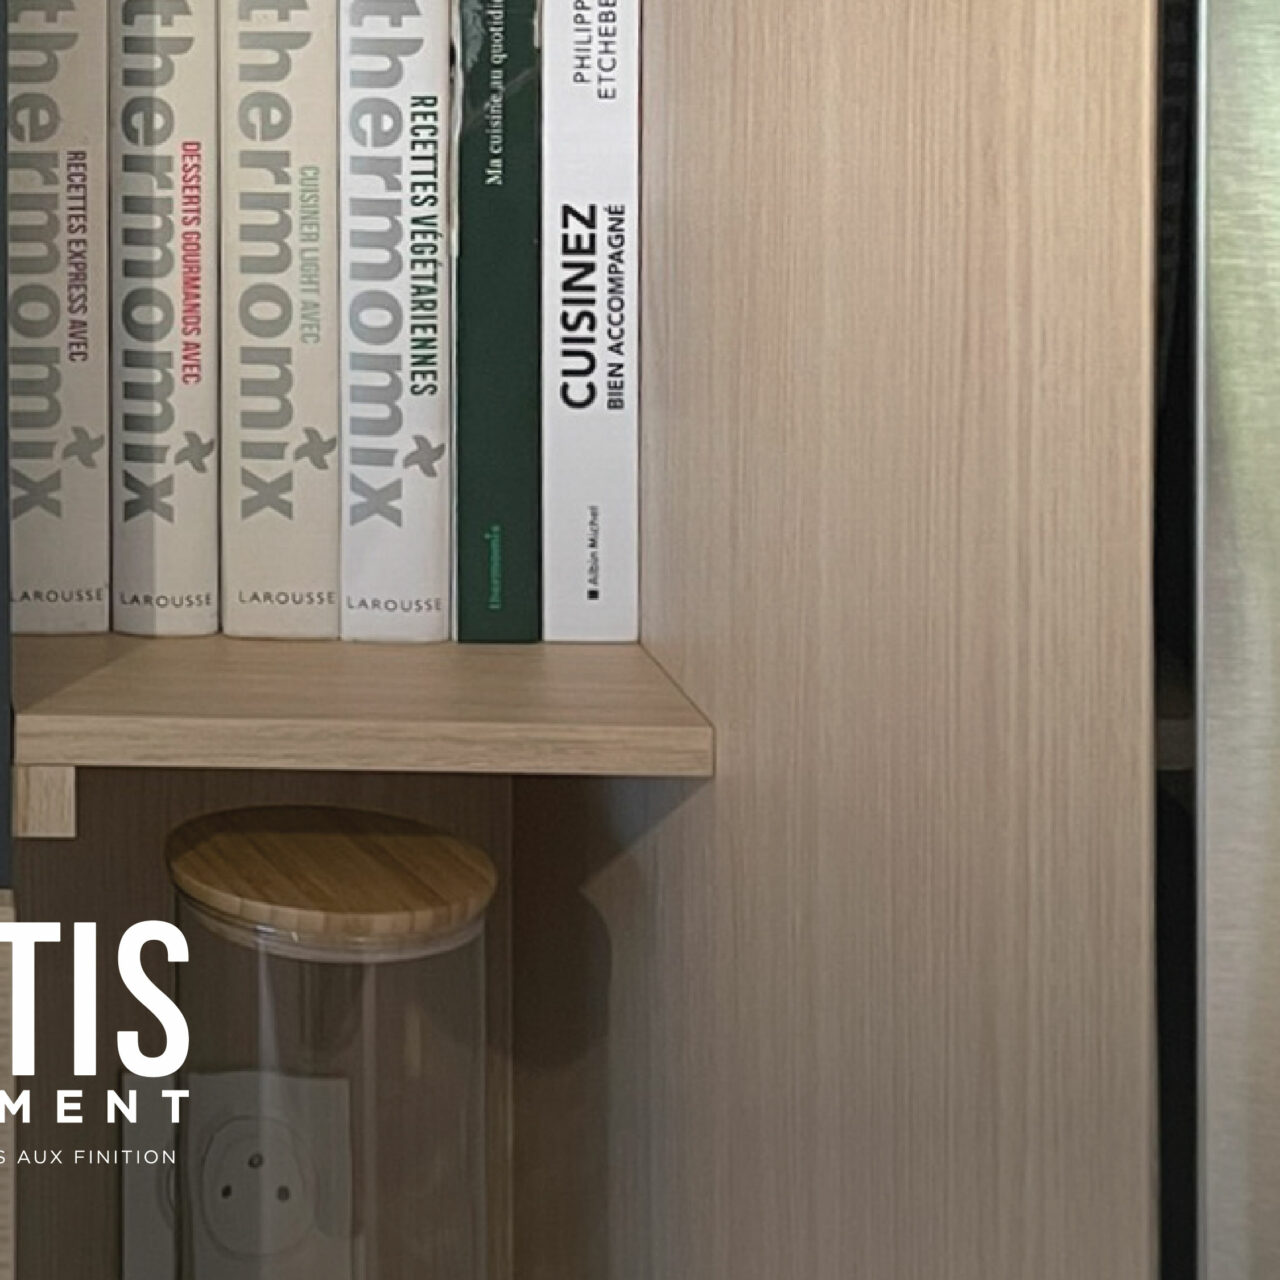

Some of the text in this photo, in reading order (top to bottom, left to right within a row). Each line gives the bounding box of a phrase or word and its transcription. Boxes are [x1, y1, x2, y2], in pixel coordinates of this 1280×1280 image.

[485, 94, 504, 154] cuisine
[490, 70, 504, 92] au
[485, 159, 504, 185] Ma
[66, 150, 88, 362] RECETTES EXPRESS AVEC
[181, 141, 201, 385] DESSERTS GOURMANDS AVEC
[299, 166, 320, 344] CUISINER LIGHT AVEC
[409, 95, 443, 396] RECETTES VÉGÉTARIENNES
[560, 203, 596, 409] CUISINEZ
[602, 204, 625, 410] BIEN ACCOMPAGNÉ
[120, 592, 213, 608] LAROUSSE
[238, 590, 336, 606] LAROUSSE
[347, 596, 443, 612] LAROUSSE
